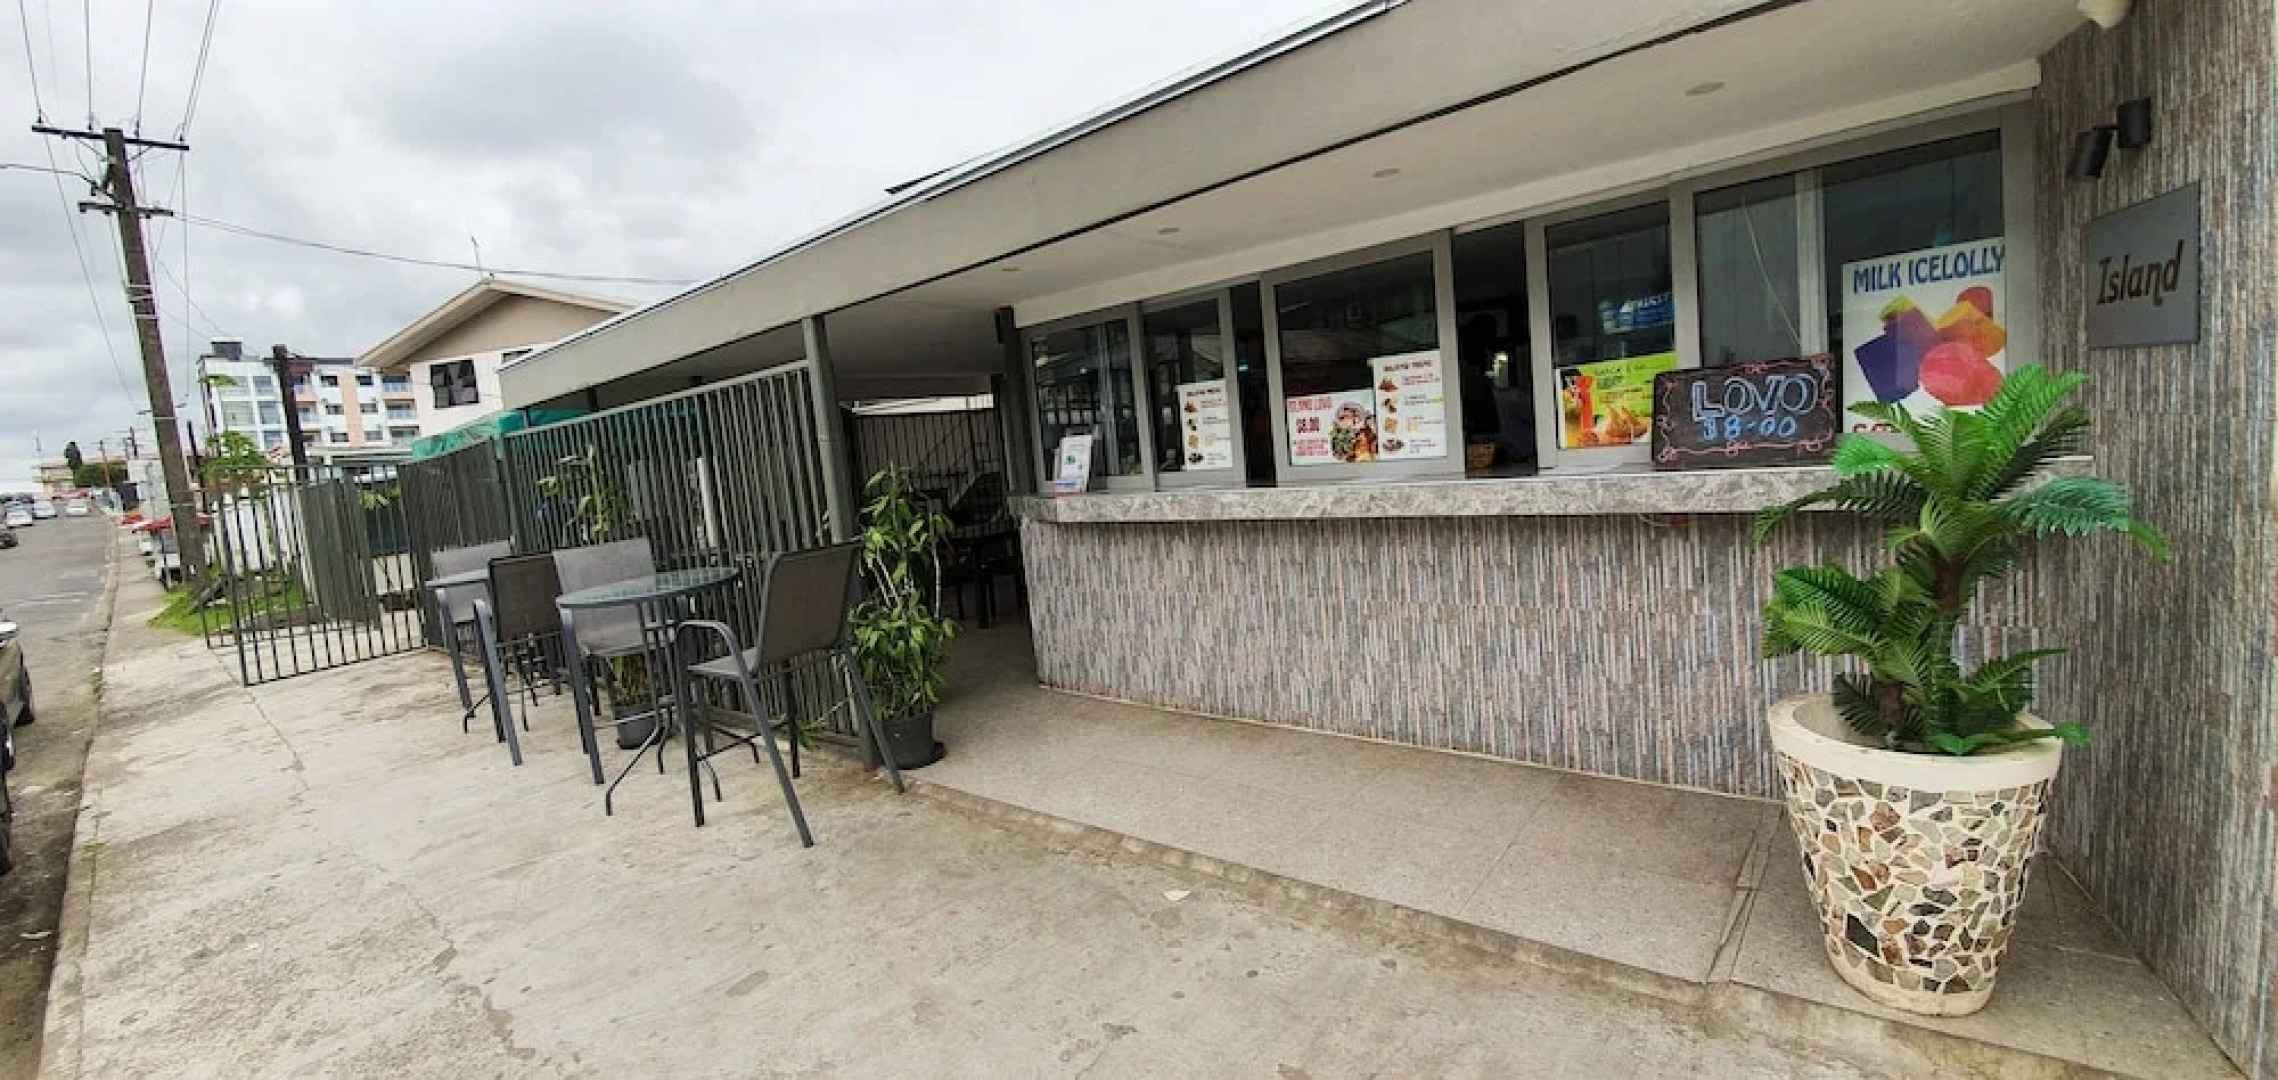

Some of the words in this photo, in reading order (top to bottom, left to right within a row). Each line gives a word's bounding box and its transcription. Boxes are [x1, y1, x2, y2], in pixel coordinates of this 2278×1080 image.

[1853, 259, 1902, 294] MILK
[1907, 243, 2005, 286] ICELOLLY
[2096, 239, 2186, 308] Island
[1691, 373, 1819, 422] LOVO
